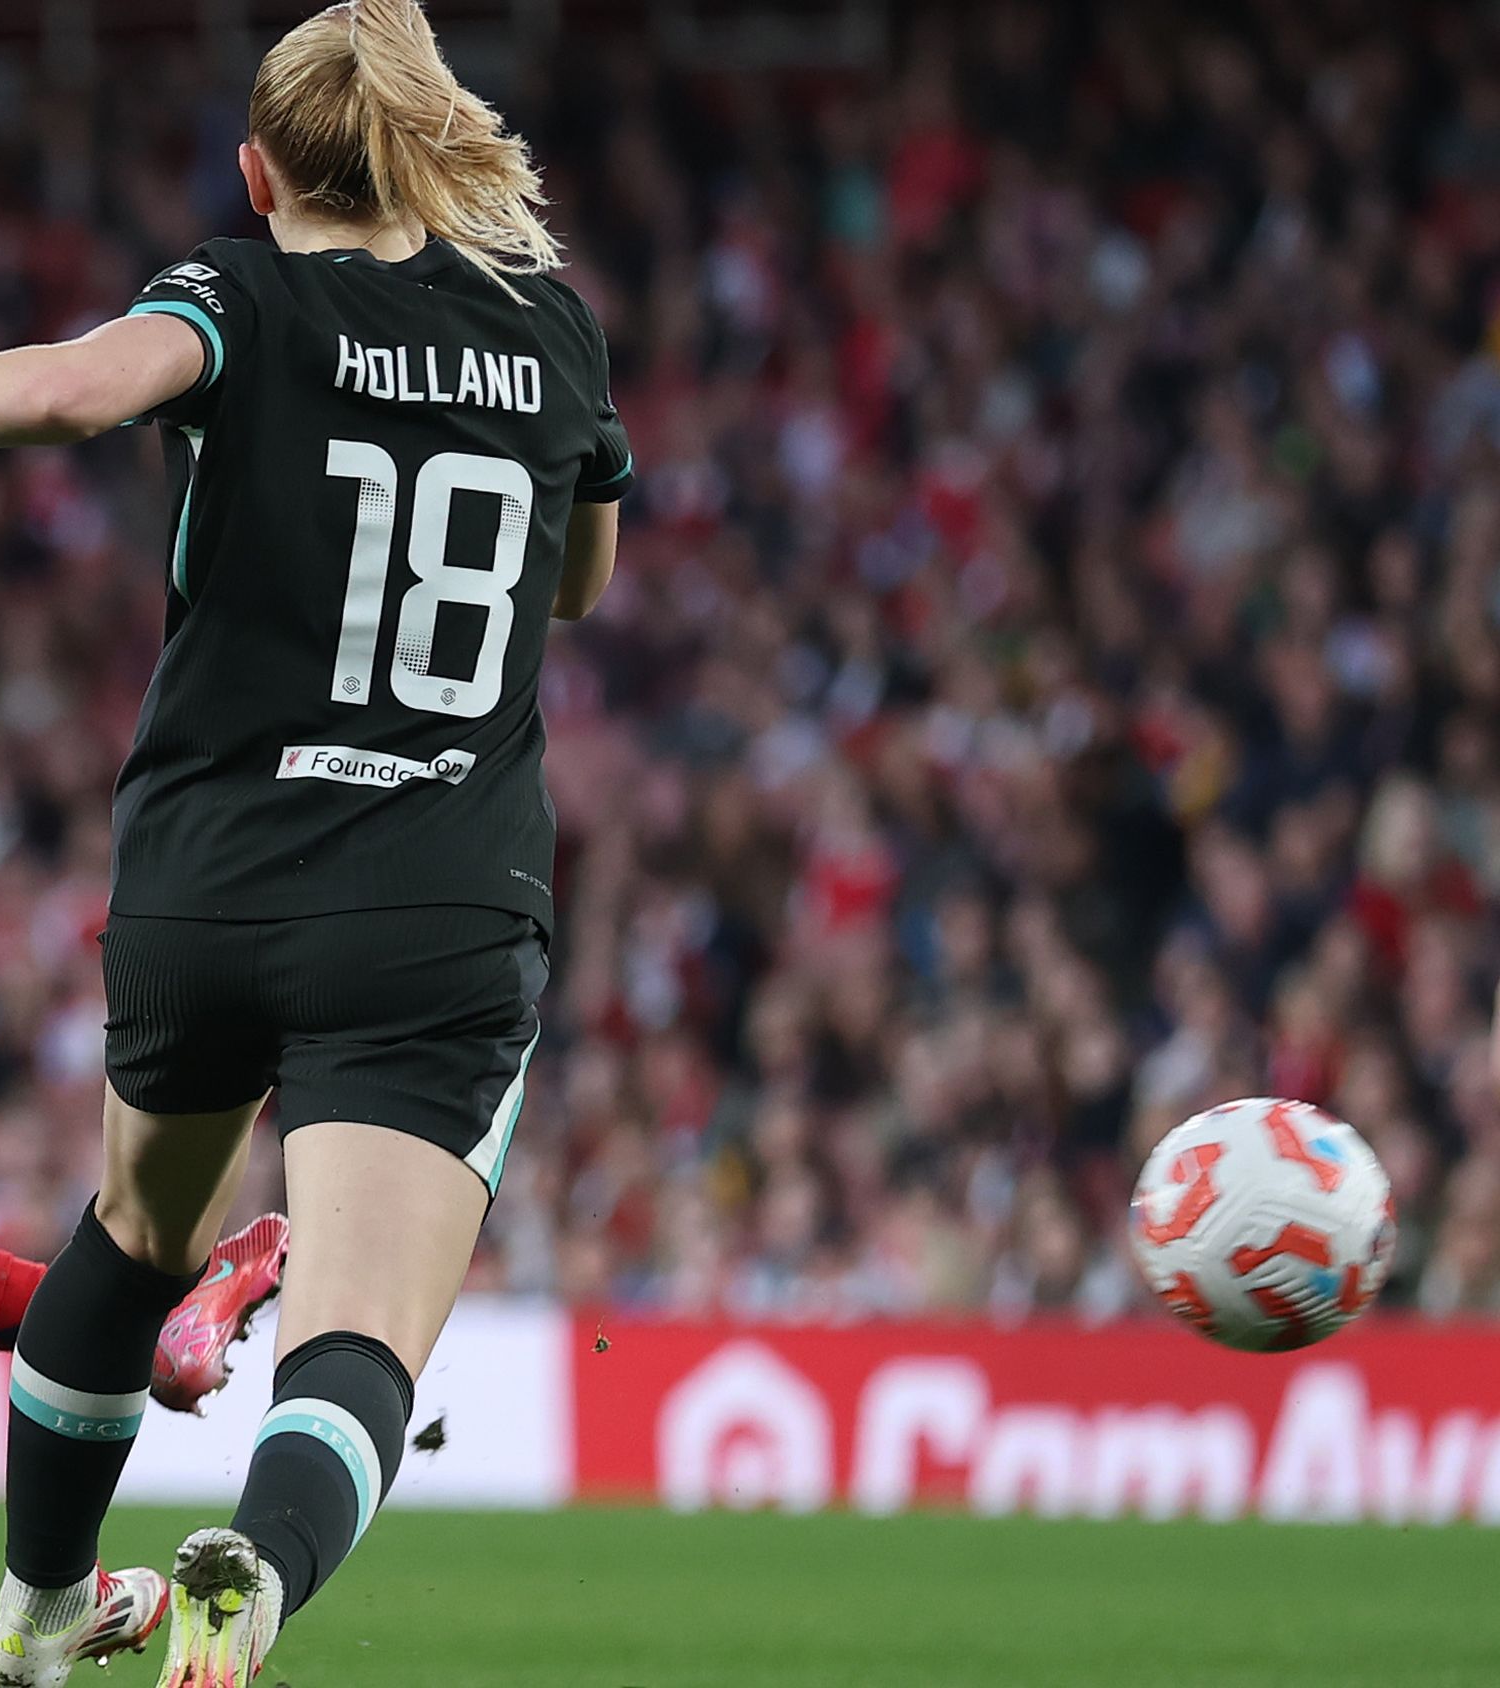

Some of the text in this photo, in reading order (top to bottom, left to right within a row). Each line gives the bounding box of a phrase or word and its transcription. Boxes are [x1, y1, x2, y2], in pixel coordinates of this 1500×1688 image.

[334, 334, 542, 414] HOLLAND
[326, 439, 534, 718] 18
[311, 751, 463, 782] Foundaon
[54, 1414, 121, 1437] LFC
[311, 1420, 361, 1471] LFC
